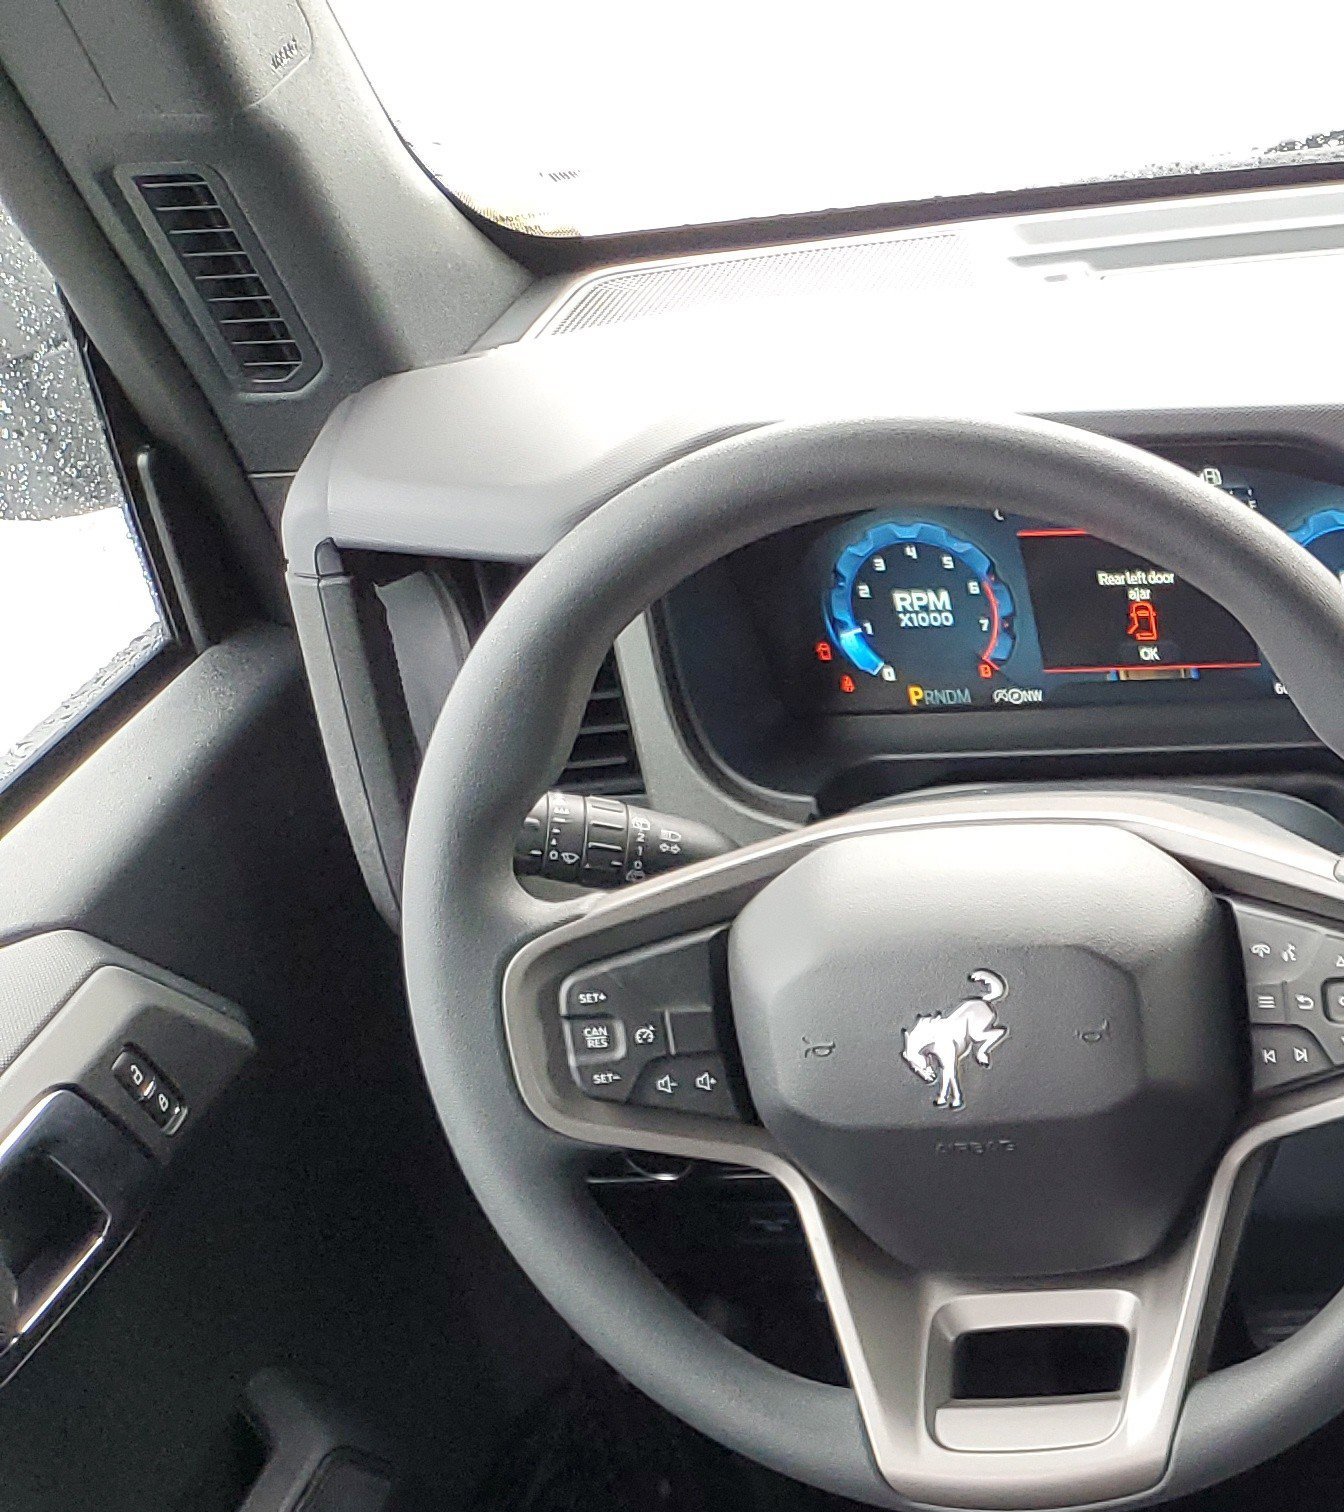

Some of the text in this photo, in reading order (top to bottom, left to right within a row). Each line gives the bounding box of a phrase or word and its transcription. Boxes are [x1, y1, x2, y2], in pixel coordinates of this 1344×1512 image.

[905, 545, 918, 559] 4
[873, 556, 886, 571] 3
[941, 555, 955, 569] 5
[1097, 570, 1174, 585] Rear left door
[857, 583, 871, 598] 2
[967, 581, 981, 595] 6
[1128, 587, 1151, 602] ajar
[893, 589, 952, 612] RPM
[899, 613, 954, 627] X1000
[979, 619, 990, 631] 7
[863, 622, 874, 634] 1
[1139, 646, 1161, 660] OK
[882, 666, 896, 681] 0
[583, 1025, 608, 1036] CAN
[586, 1039, 608, 1049] RES
